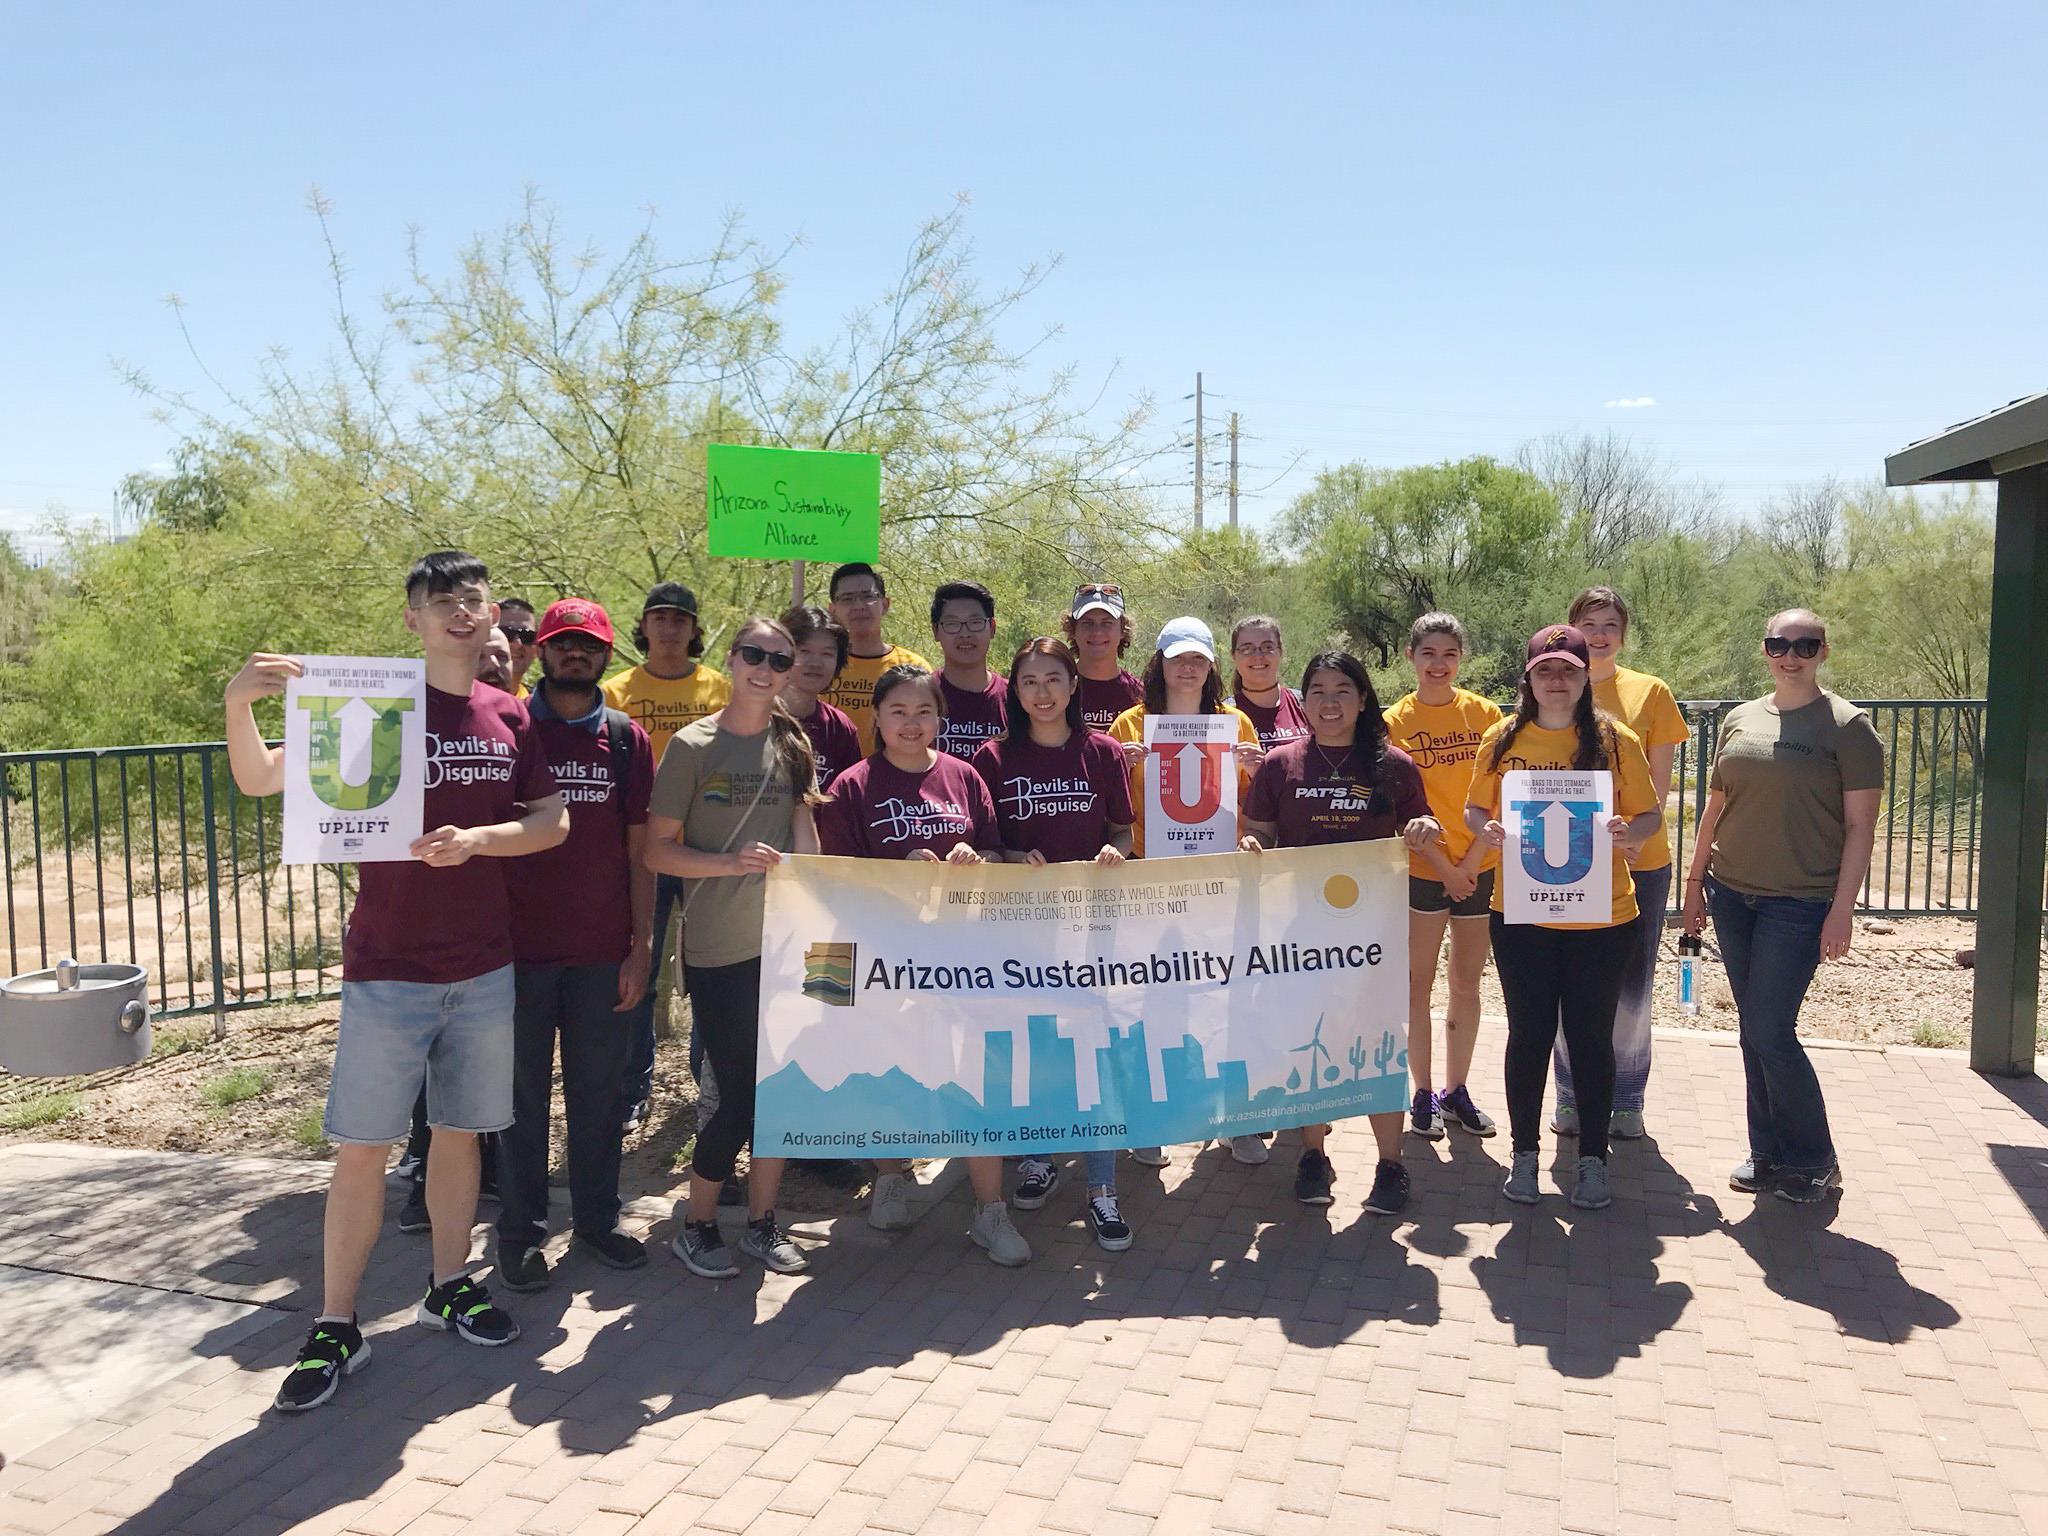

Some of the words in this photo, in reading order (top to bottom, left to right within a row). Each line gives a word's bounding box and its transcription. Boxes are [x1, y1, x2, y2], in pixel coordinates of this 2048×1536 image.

[713, 476, 769, 519] Arizona
[764, 522, 819, 546] Alliance
[312, 668, 350, 677] VOLUNTEERS
[353, 669, 368, 678] WITH
[370, 670, 389, 678] GREEN
[391, 670, 416, 679] THUMBS
[329, 679, 341, 687] AND
[344, 680, 359, 688] GOLD
[361, 680, 384, 688] HEARTS
[630, 699, 689, 717] Devils
[695, 702, 708, 712] in
[1081, 709, 1114, 722] evils
[988, 723, 1000, 735] in
[1296, 726, 1308, 735] in
[492, 738, 509, 754] in
[1407, 731, 1464, 749] Devils
[1469, 730, 1481, 742] in
[1412, 748, 1476, 768] Disguis
[592, 763, 609, 779] in
[559, 782, 616, 805] guise
[1003, 776, 1070, 797] Devils
[1075, 778, 1088, 791] in
[1295, 787, 1348, 798] PAT'S
[875, 798, 942, 819] Devils
[948, 801, 961, 815] in
[1005, 794, 1097, 820] Disguise
[1329, 799, 1368, 810] RUN
[319, 821, 389, 834] UPLIFT
[879, 817, 969, 843] Disguise
[1167, 832, 1214, 840] UPLIFT
[948, 891, 985, 904] UNLESS
[988, 891, 1034, 904] SOMEONE
[1038, 891, 1059, 904] LIKE
[1062, 890, 1082, 903] YOU
[1085, 889, 1116, 902] CARES
[1120, 889, 1126, 901] A
[1128, 886, 1165, 900] WHOLE
[1168, 884, 1202, 898] AWFUL
[1529, 893, 1585, 901] UPLIFT
[980, 908, 997, 921] IT'S
[999, 908, 1031, 921] NEVER
[1034, 907, 1065, 920] GOING
[1069, 906, 1081, 918] TO
[1085, 905, 1101, 918] GET
[1146, 902, 1164, 915] IT'S
[1089, 923, 1111, 931] Seuss
[864, 958, 995, 990] Arizona
[1002, 950, 1234, 989] Sustainability
[1246, 943, 1382, 976] Alliance
[1208, 1092, 1373, 1125] www.azsustainabilityalliance.com
[783, 1131, 866, 1147] Advancing
[871, 1129, 980, 1147] Sustainability
[982, 1128, 1003, 1143] for
[1007, 1131, 1016, 1141] a
[1020, 1125, 1066, 1141] Better
[1070, 1122, 1128, 1138] Arizona
